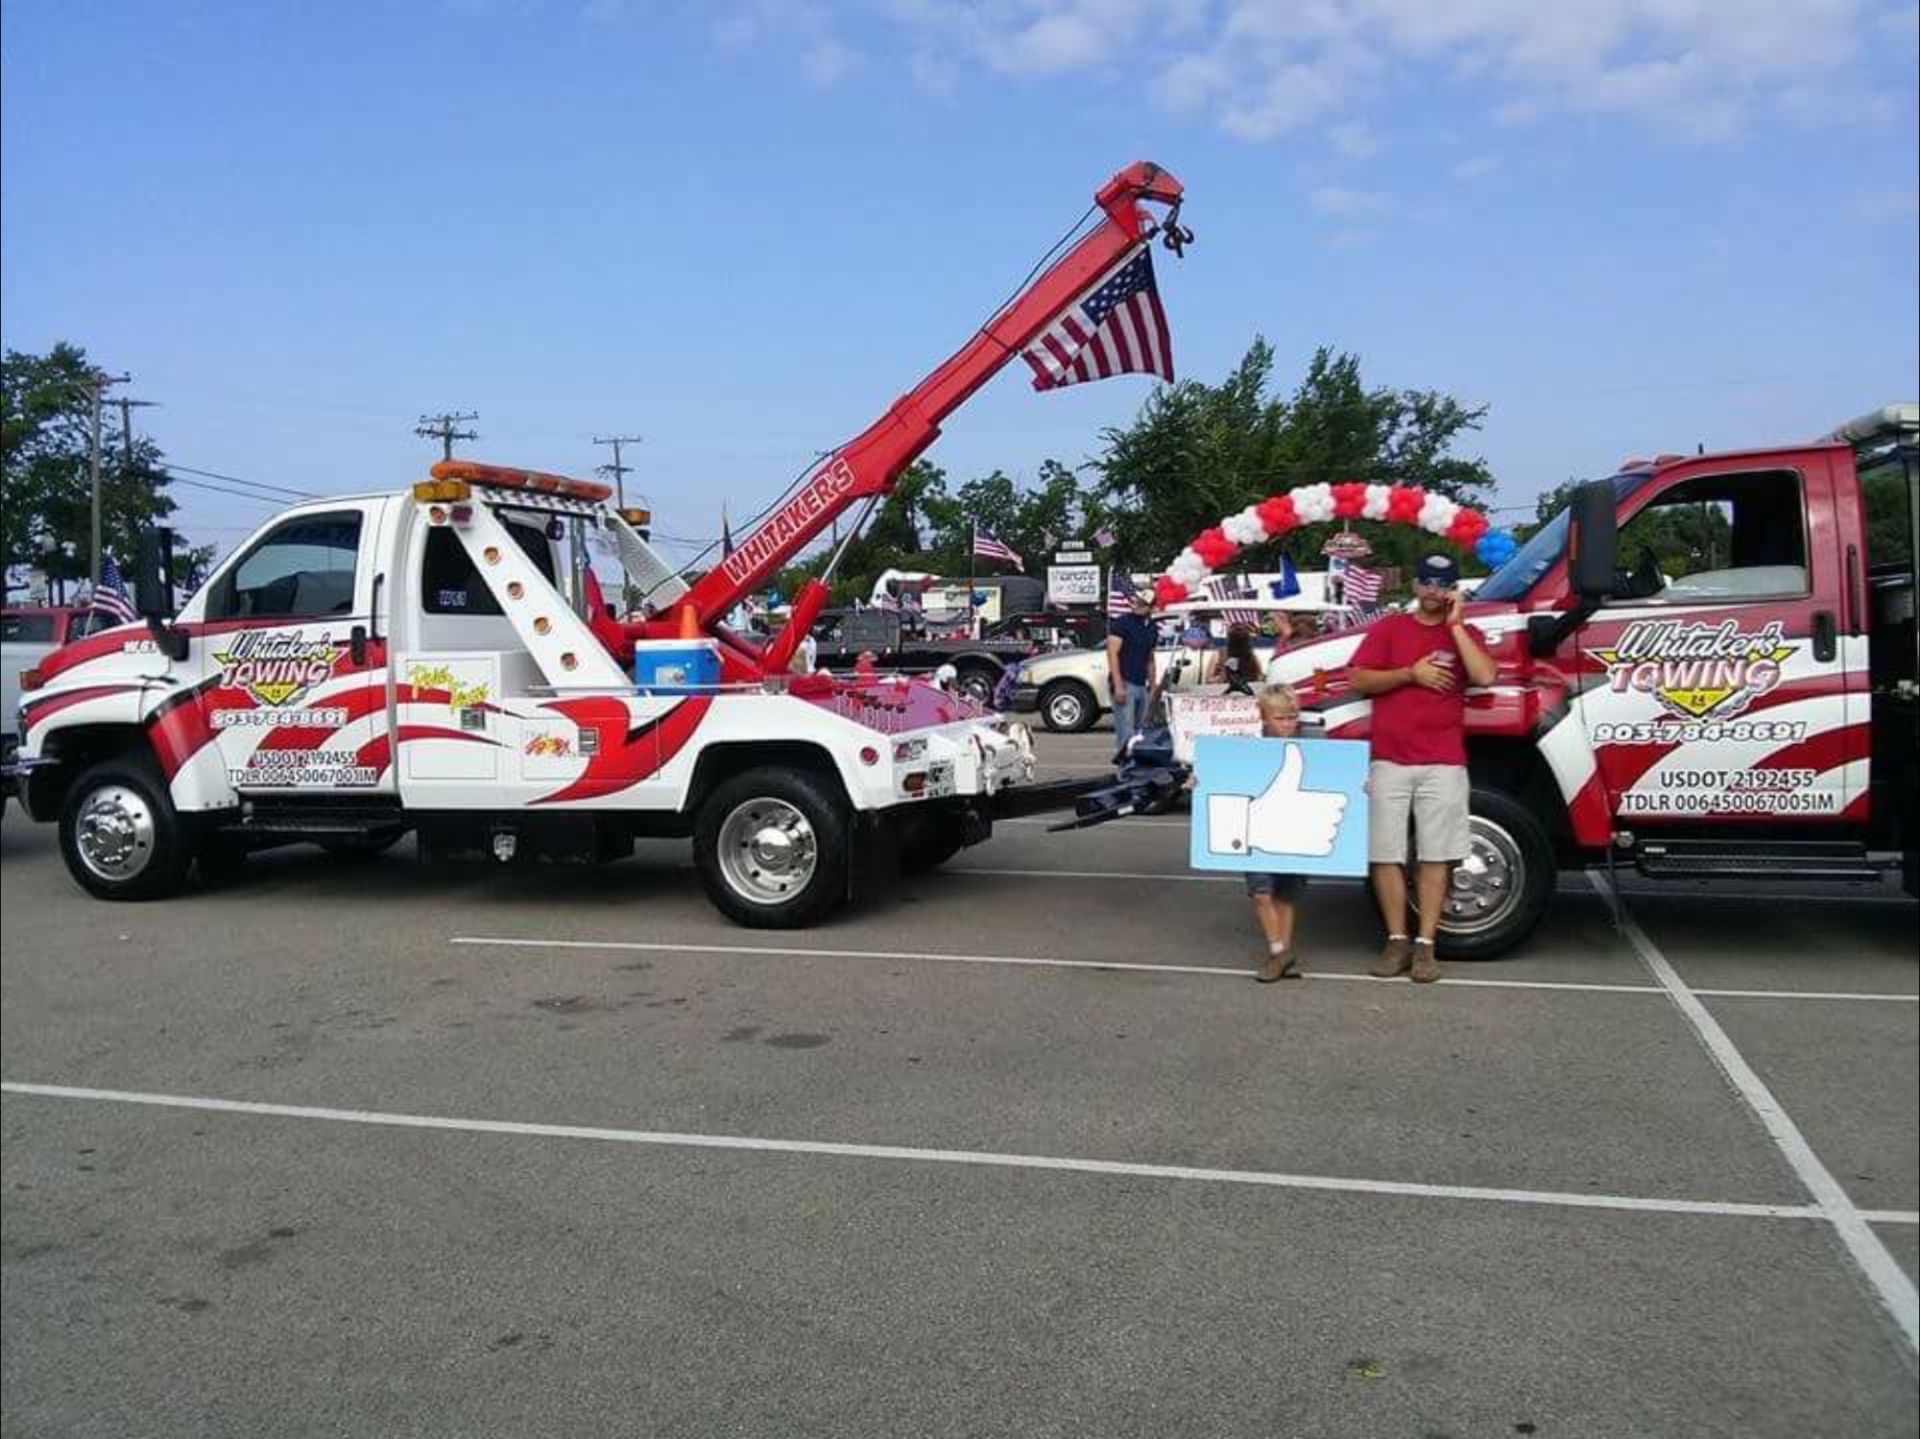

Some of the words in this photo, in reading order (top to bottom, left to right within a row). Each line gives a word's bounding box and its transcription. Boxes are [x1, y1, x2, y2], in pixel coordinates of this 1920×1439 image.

[722, 457, 854, 586] WHITAKER'S
[229, 629, 333, 660] Whitaker's
[1616, 620, 1783, 657] Whitaker's
[220, 660, 331, 689] TOWING
[1608, 660, 1781, 693] TOWING
[210, 709, 349, 728] 903-784-8691
[1593, 722, 1807, 743] 903-784-8691
[255, 751, 297, 765] USDOT
[302, 751, 356, 766] 2192455
[229, 768, 260, 783] TDLR
[1660, 770, 1729, 788] USDOT
[1734, 770, 1814, 788] 2192455
[1624, 793, 1670, 811] TDLR
[1674, 793, 1835, 811] 006450067005IM
